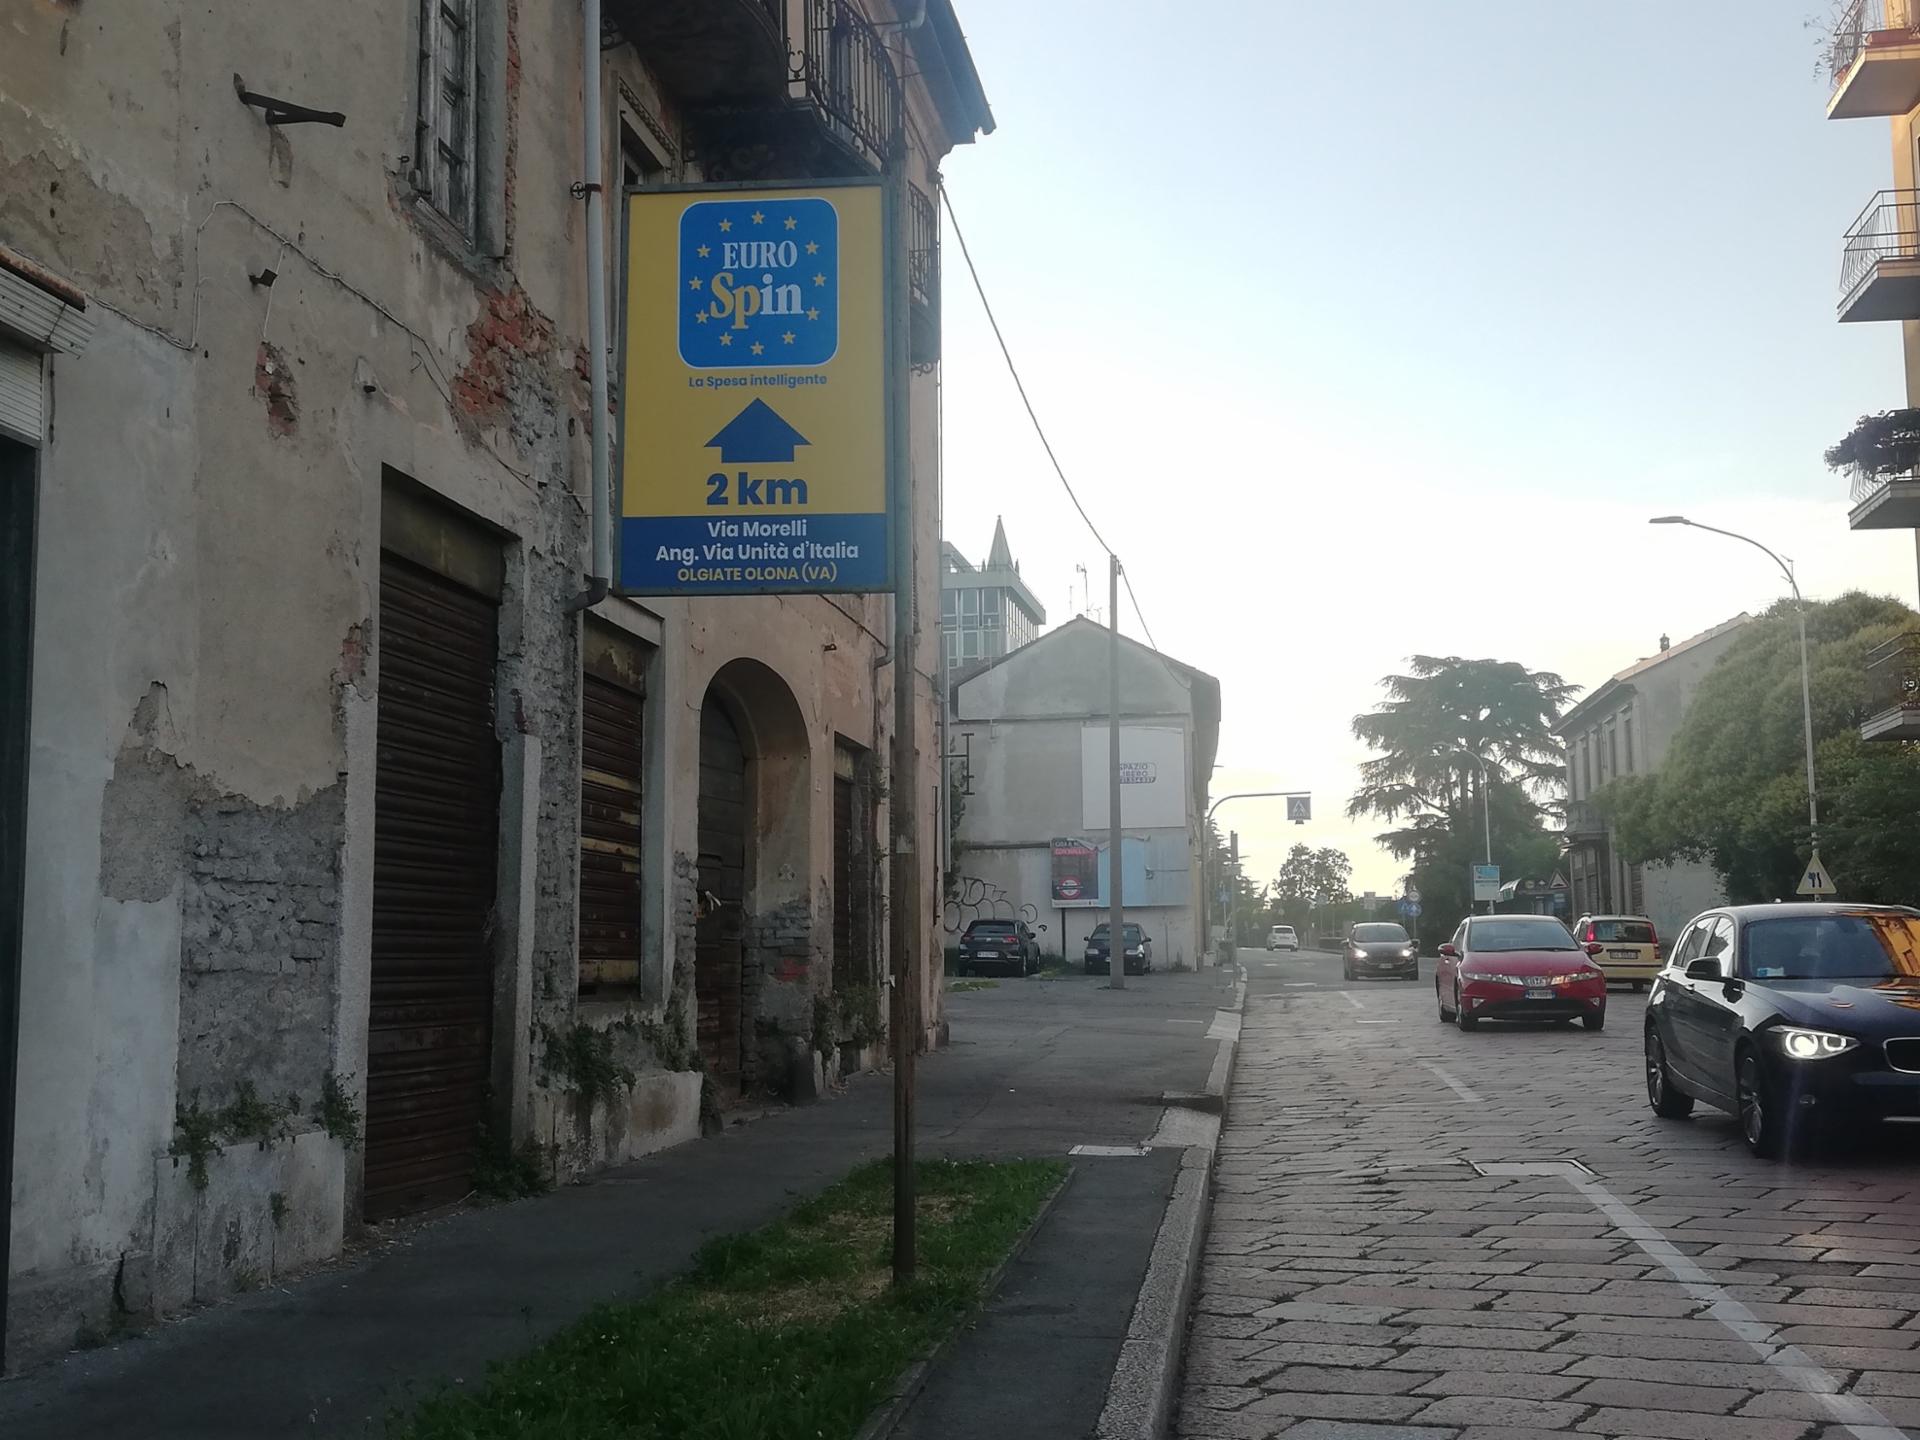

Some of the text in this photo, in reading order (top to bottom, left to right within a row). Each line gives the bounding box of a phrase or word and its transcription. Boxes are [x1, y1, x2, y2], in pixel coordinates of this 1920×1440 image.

[722, 240, 798, 270] EURO
[710, 272, 804, 329] Spin
[688, 373, 827, 390] La Spesa intelligente
[706, 471, 808, 505] 2 km
[707, 519, 807, 538] Via Morelli
[656, 545, 699, 566] Ang.
[702, 542, 734, 561] Via
[738, 542, 789, 560] Unità
[677, 561, 838, 583] OLGIATE OLONA (VA)
